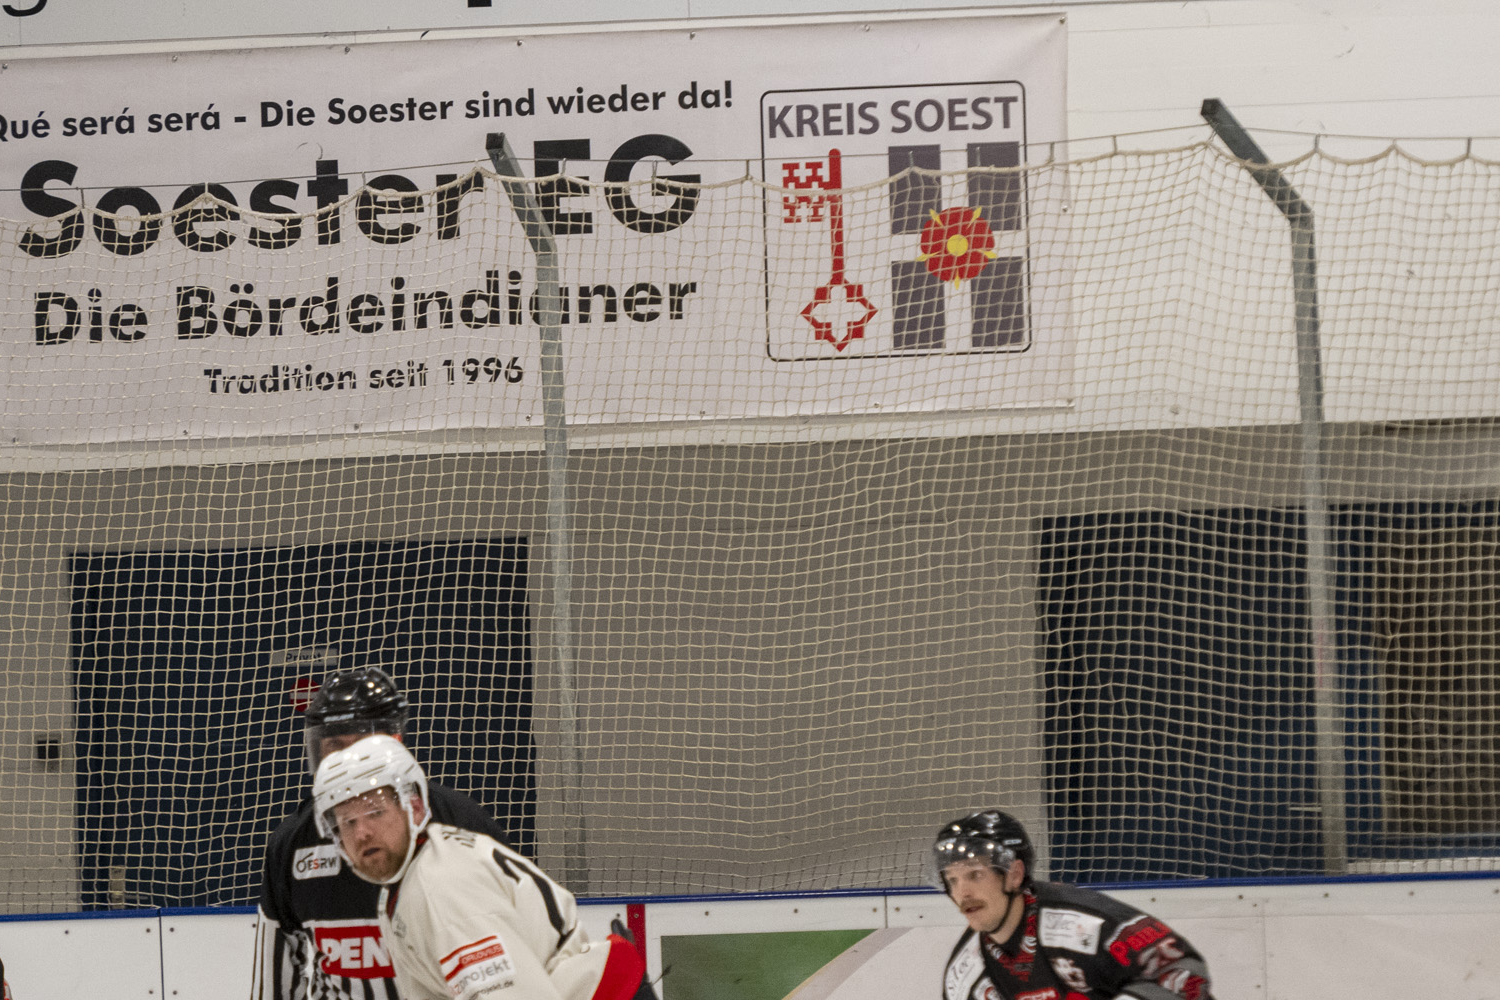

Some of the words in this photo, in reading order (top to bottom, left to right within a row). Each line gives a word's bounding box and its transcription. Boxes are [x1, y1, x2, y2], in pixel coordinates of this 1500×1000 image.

[62, 106, 136, 136] será
[148, 103, 221, 133] será
[260, 100, 315, 128] Die
[328, 95, 452, 125] Soester
[464, 89, 535, 119] sind
[548, 84, 666, 115] wieder
[677, 80, 733, 109] da!
[767, 102, 880, 139] KREIS
[890, 97, 1018, 134] SOEST
[18, 159, 485, 258] Soester
[533, 133, 700, 235] EG
[33, 288, 148, 345] Die
[176, 270, 697, 341] Bördeindianer
[204, 364, 357, 394] Tradition
[369, 361, 429, 389] seit
[442, 356, 523, 385] 1996
